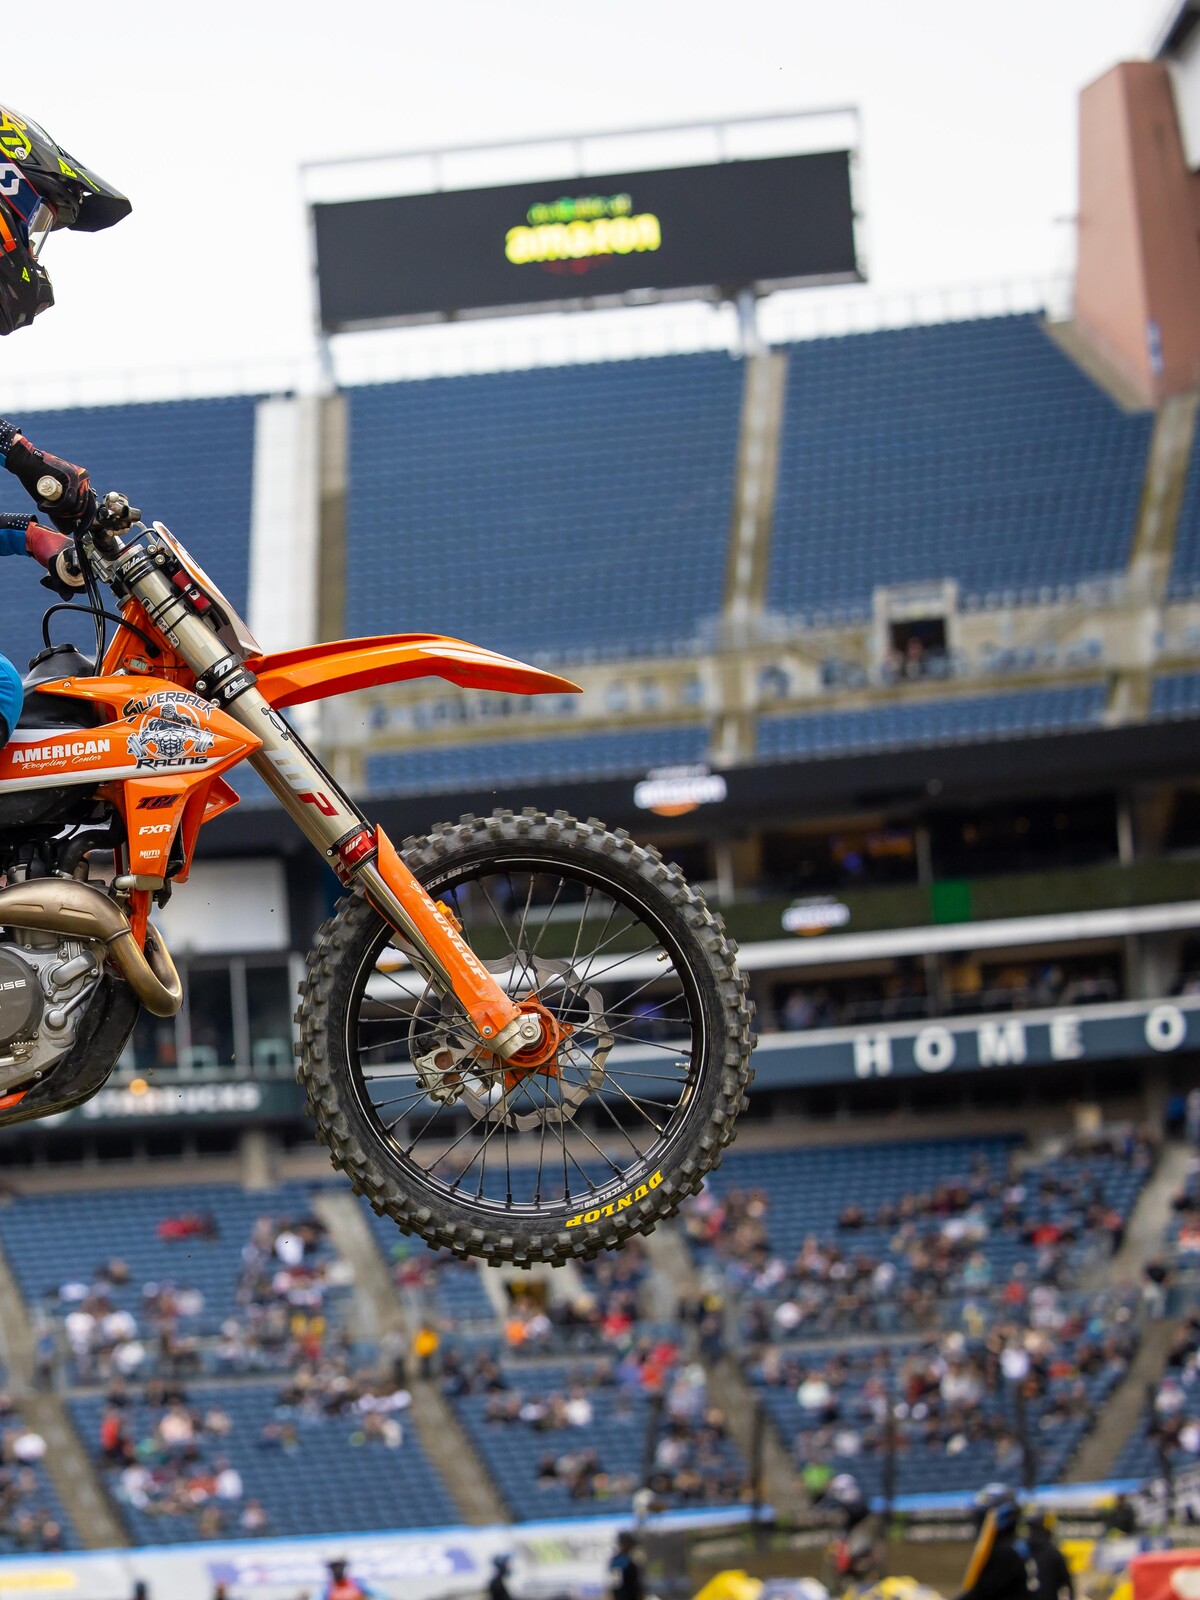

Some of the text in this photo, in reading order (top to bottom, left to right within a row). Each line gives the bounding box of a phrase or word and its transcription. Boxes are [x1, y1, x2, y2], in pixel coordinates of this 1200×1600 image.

[122, 691, 215, 721] SILVERBACK
[11, 739, 110, 763] AMERICAN
[22, 754, 101, 770] Recycling Center
[135, 755, 208, 771] RACING
[139, 824, 171, 835] FXR
[421, 897, 487, 980] DUNLOP
[853, 1013, 1084, 1079] HOME
[565, 1170, 664, 1227] DUNLOP
